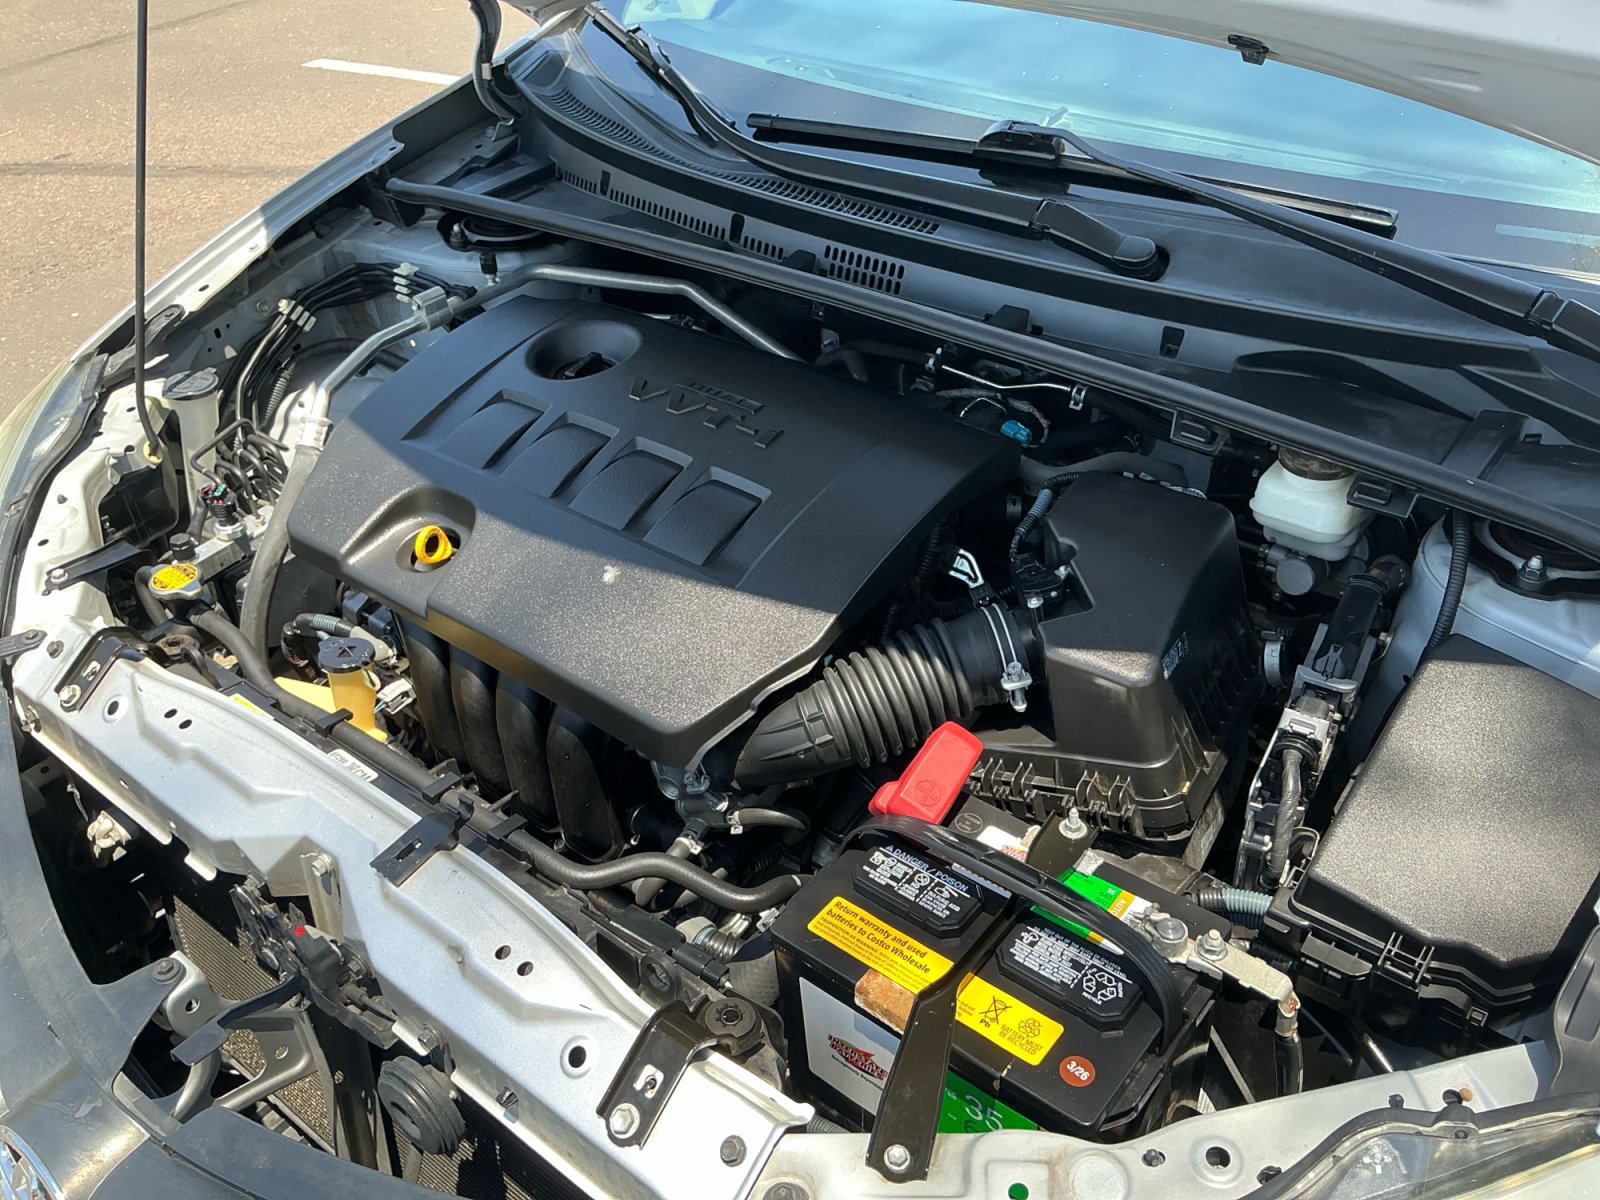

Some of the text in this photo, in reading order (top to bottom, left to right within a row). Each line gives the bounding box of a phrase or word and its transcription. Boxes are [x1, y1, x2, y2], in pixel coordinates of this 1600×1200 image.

[893, 849, 929, 871] DANGER
[935, 871, 968, 892] POISON
[826, 908, 858, 931] batteries
[857, 927, 867, 936] to
[866, 933, 891, 950] Costco
[891, 946, 930, 973] Wholesale
[834, 901, 928, 958] Return warranty and used
[979, 1018, 991, 1028] Pb
[1001, 1024, 1043, 1051] BATTERY MUST
[998, 1030, 1037, 1055] BE RECYCLED
[1066, 1060, 1090, 1081] 3/26
[965, 1095, 1003, 1131] 35
